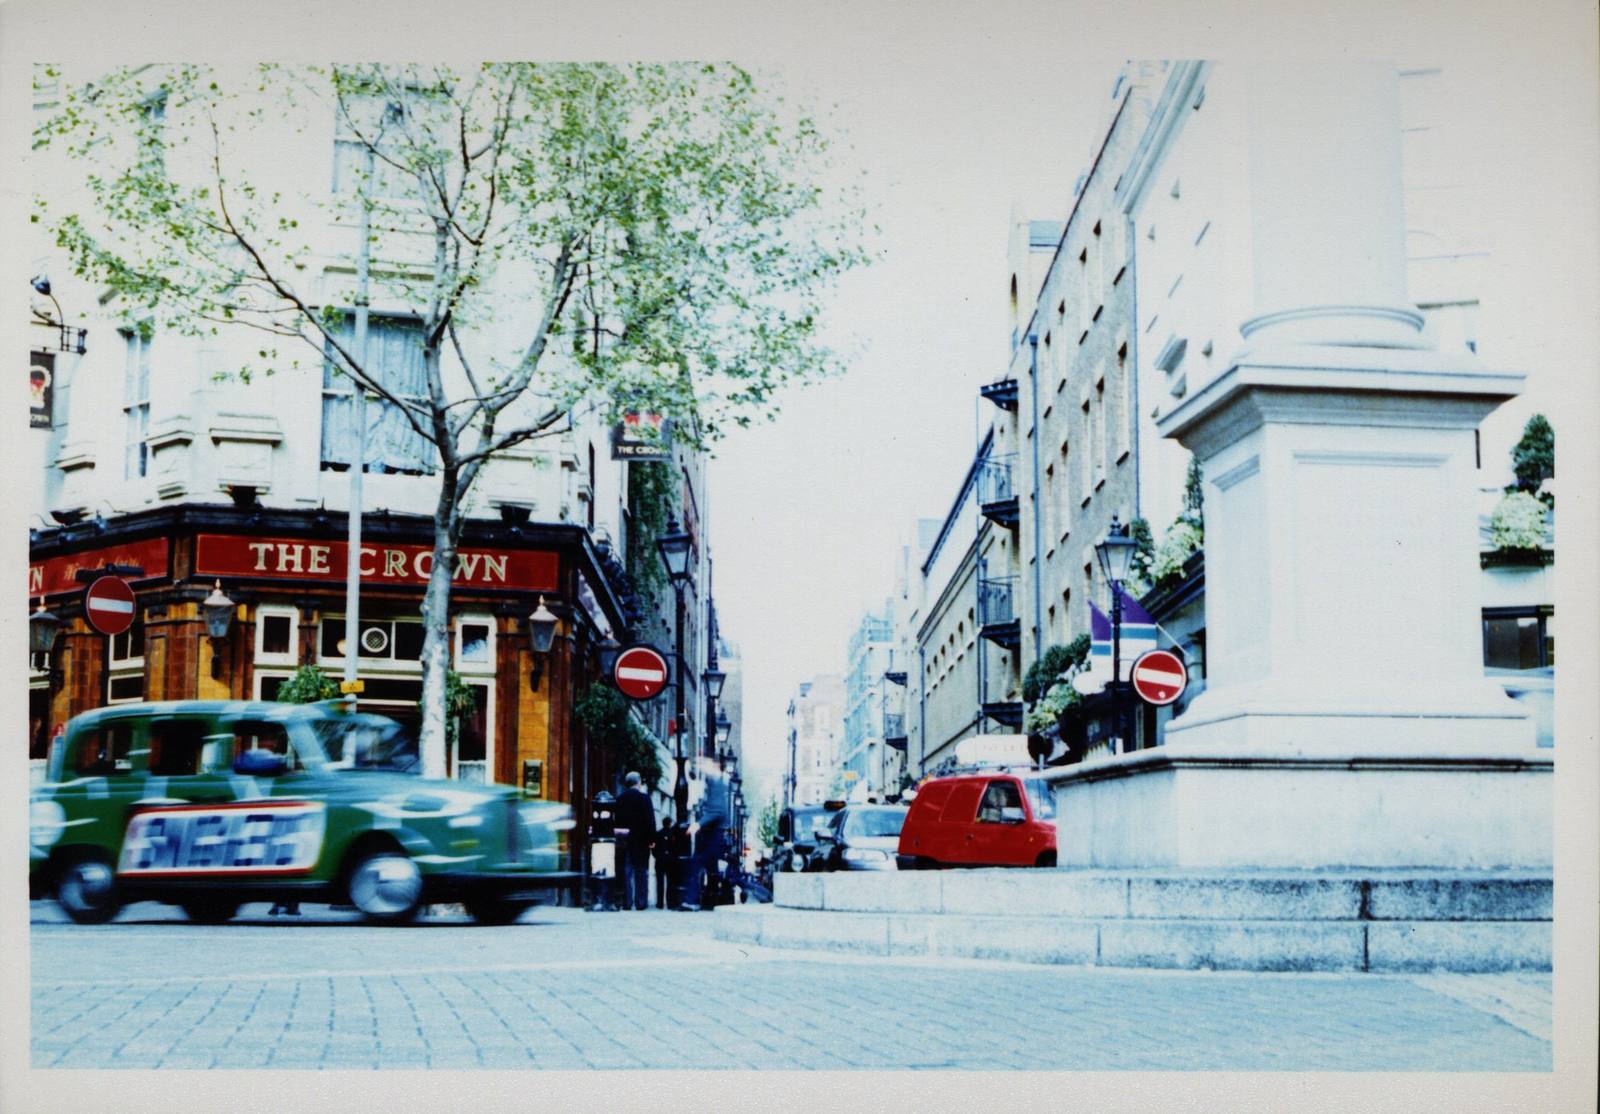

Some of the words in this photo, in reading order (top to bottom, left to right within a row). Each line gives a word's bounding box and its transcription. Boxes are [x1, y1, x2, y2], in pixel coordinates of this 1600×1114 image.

[617, 446, 634, 454] THE
[249, 542, 331, 574] THE
[358, 547, 509, 582] CROWN
